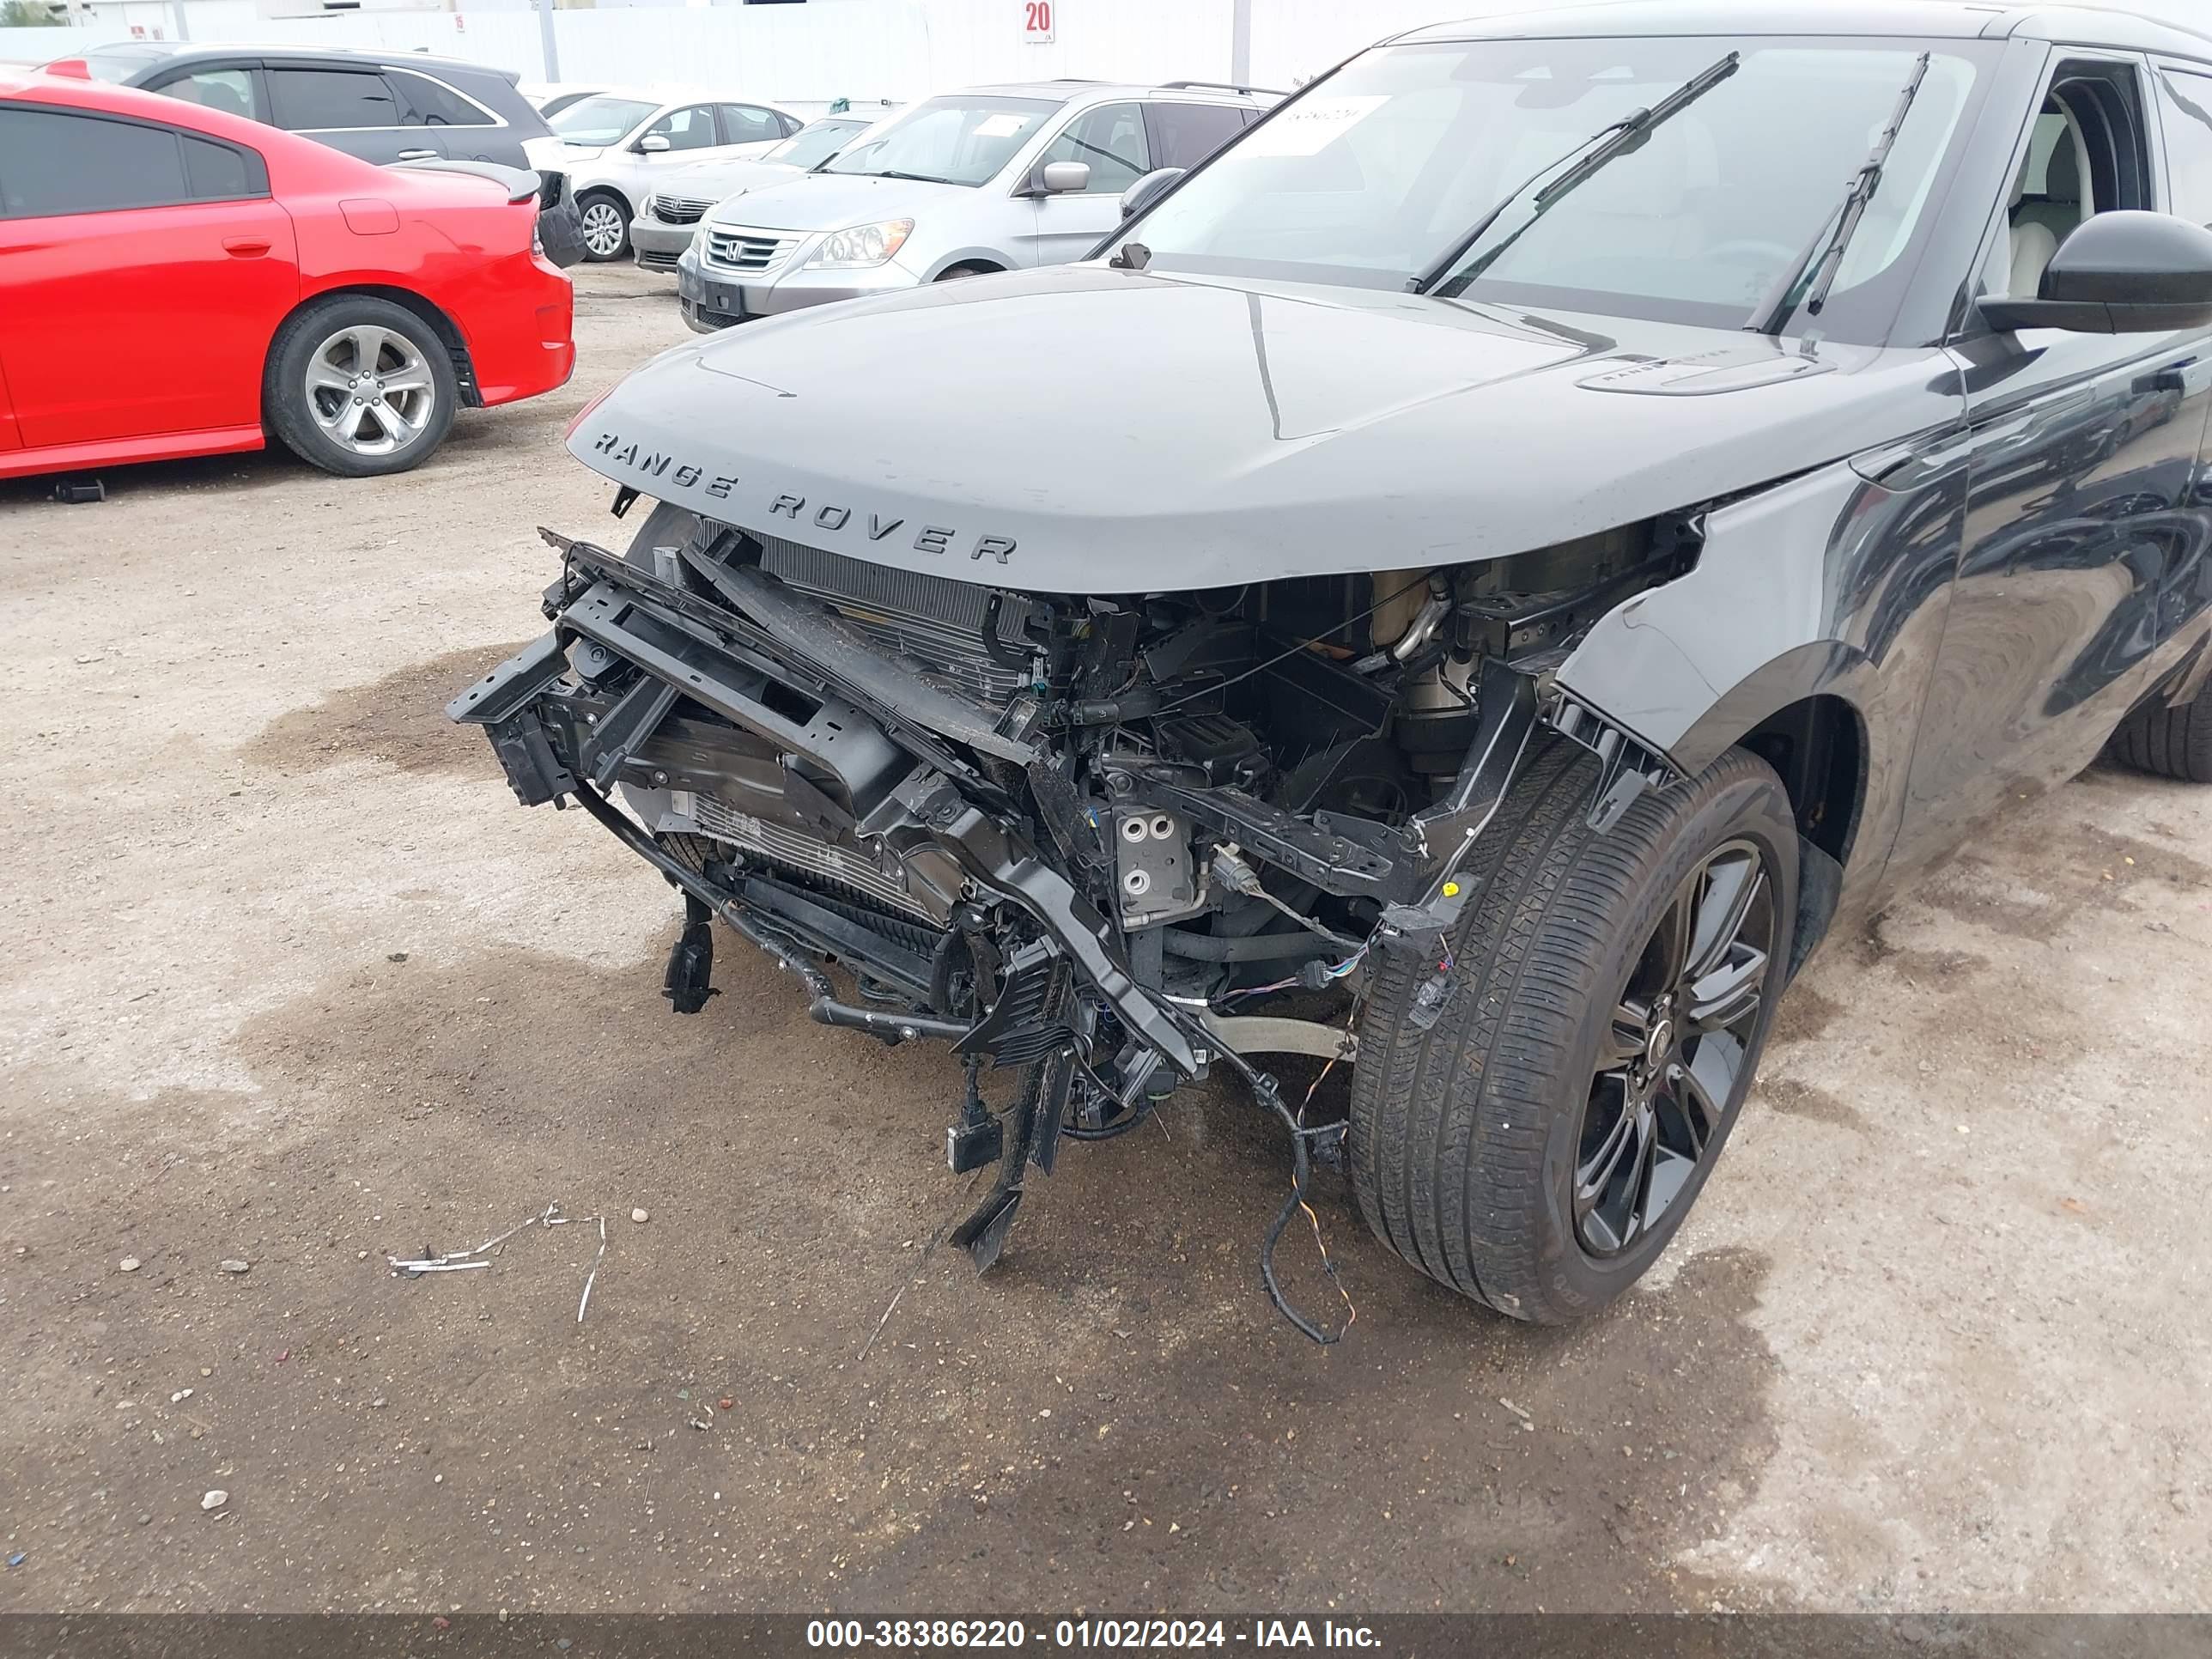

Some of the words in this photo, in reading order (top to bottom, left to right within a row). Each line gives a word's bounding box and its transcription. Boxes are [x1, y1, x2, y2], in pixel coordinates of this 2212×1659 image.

[1026, 2, 1049, 31] 20
[594, 433, 739, 499] RANGE
[769, 494, 1018, 564] ROVER
